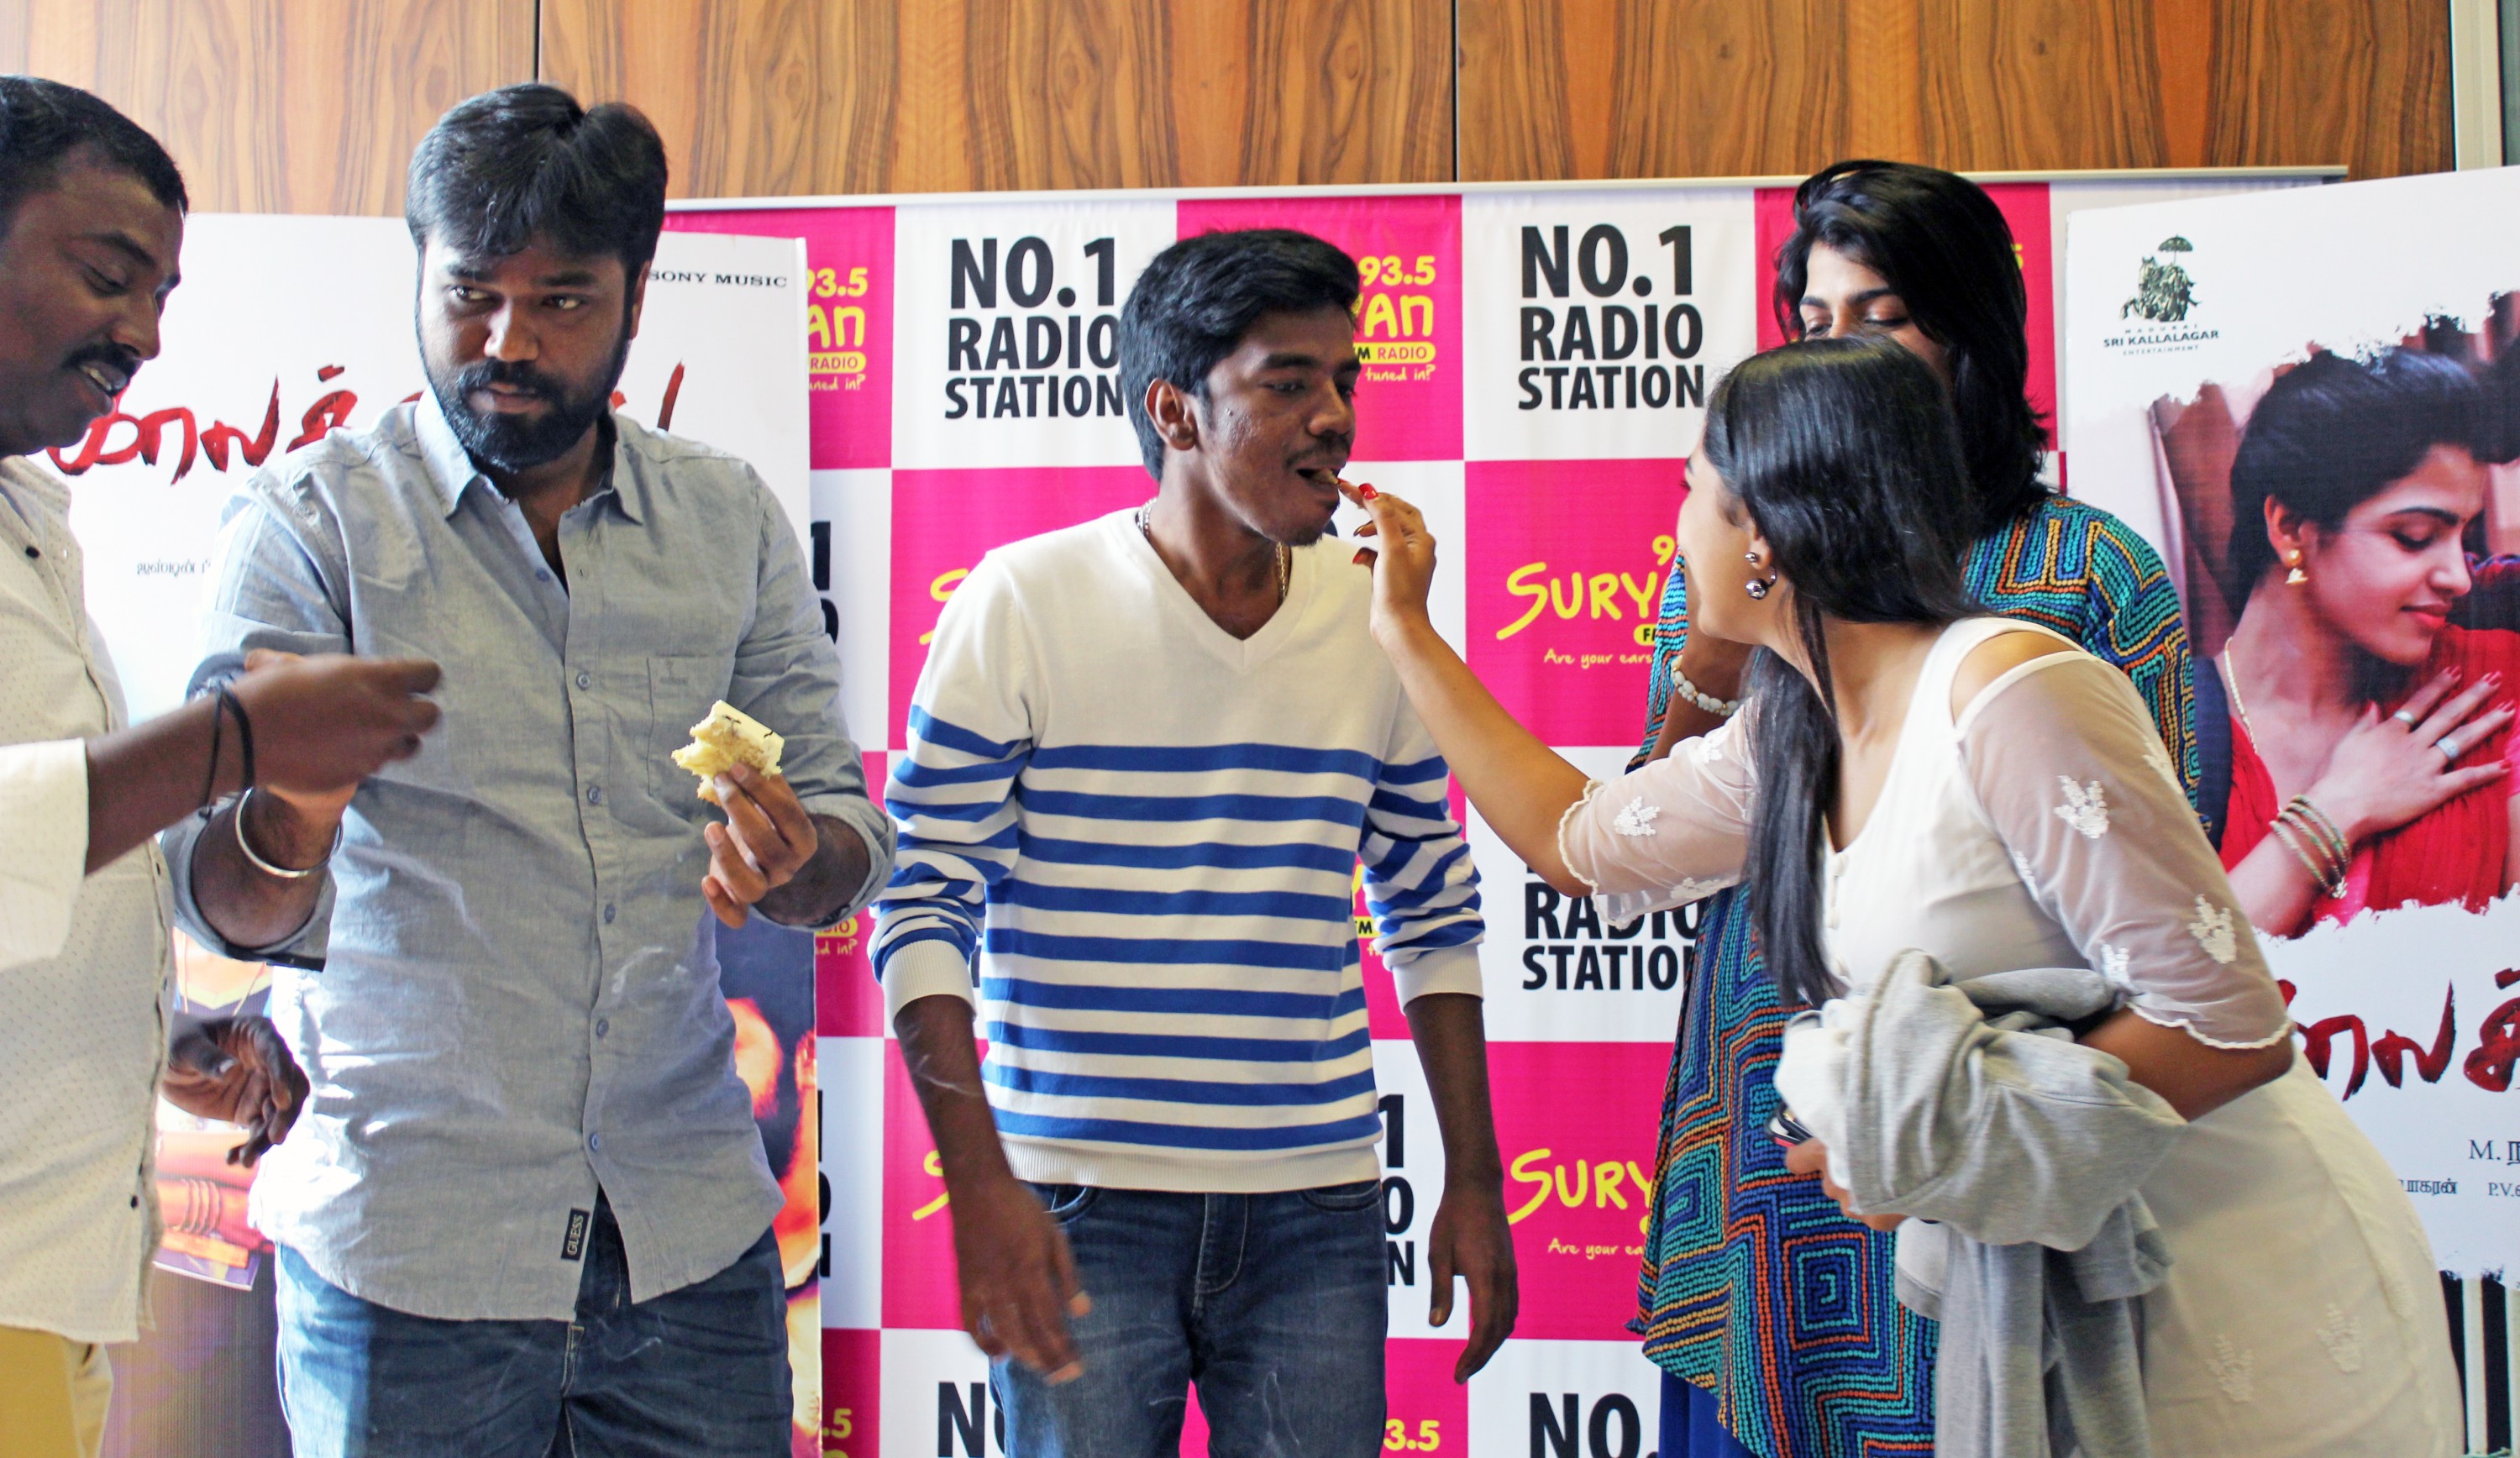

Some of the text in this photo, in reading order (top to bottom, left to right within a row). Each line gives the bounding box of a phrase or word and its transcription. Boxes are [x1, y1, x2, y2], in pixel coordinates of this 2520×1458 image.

[951, 236, 1115, 309] NO.1
[1358, 255, 1436, 286] 93.5
[1521, 223, 1692, 298] NO.1
[648, 270, 787, 287] SONY MUSIC
[948, 314, 1121, 370] RADIO
[1520, 303, 1704, 362] RADIO
[2103, 330, 2219, 348] SRI KALLALAGAR
[2125, 323, 2197, 334] MADURAI
[811, 356, 858, 370] RADIO
[1352, 346, 1428, 360] M RADIO
[2123, 344, 2199, 356] ENTERTAINMENT
[1365, 364, 1436, 381] tuned in?
[945, 375, 1125, 419] STATION
[1518, 364, 1705, 410] STATION
[1496, 562, 1663, 640] SURY
[1544, 648, 1575, 665] Are
[1581, 654, 1613, 669] your
[1548, 1237, 1579, 1255] Are
[1585, 1244, 1619, 1260] your
[1383, 1419, 1441, 1451] 3.5
